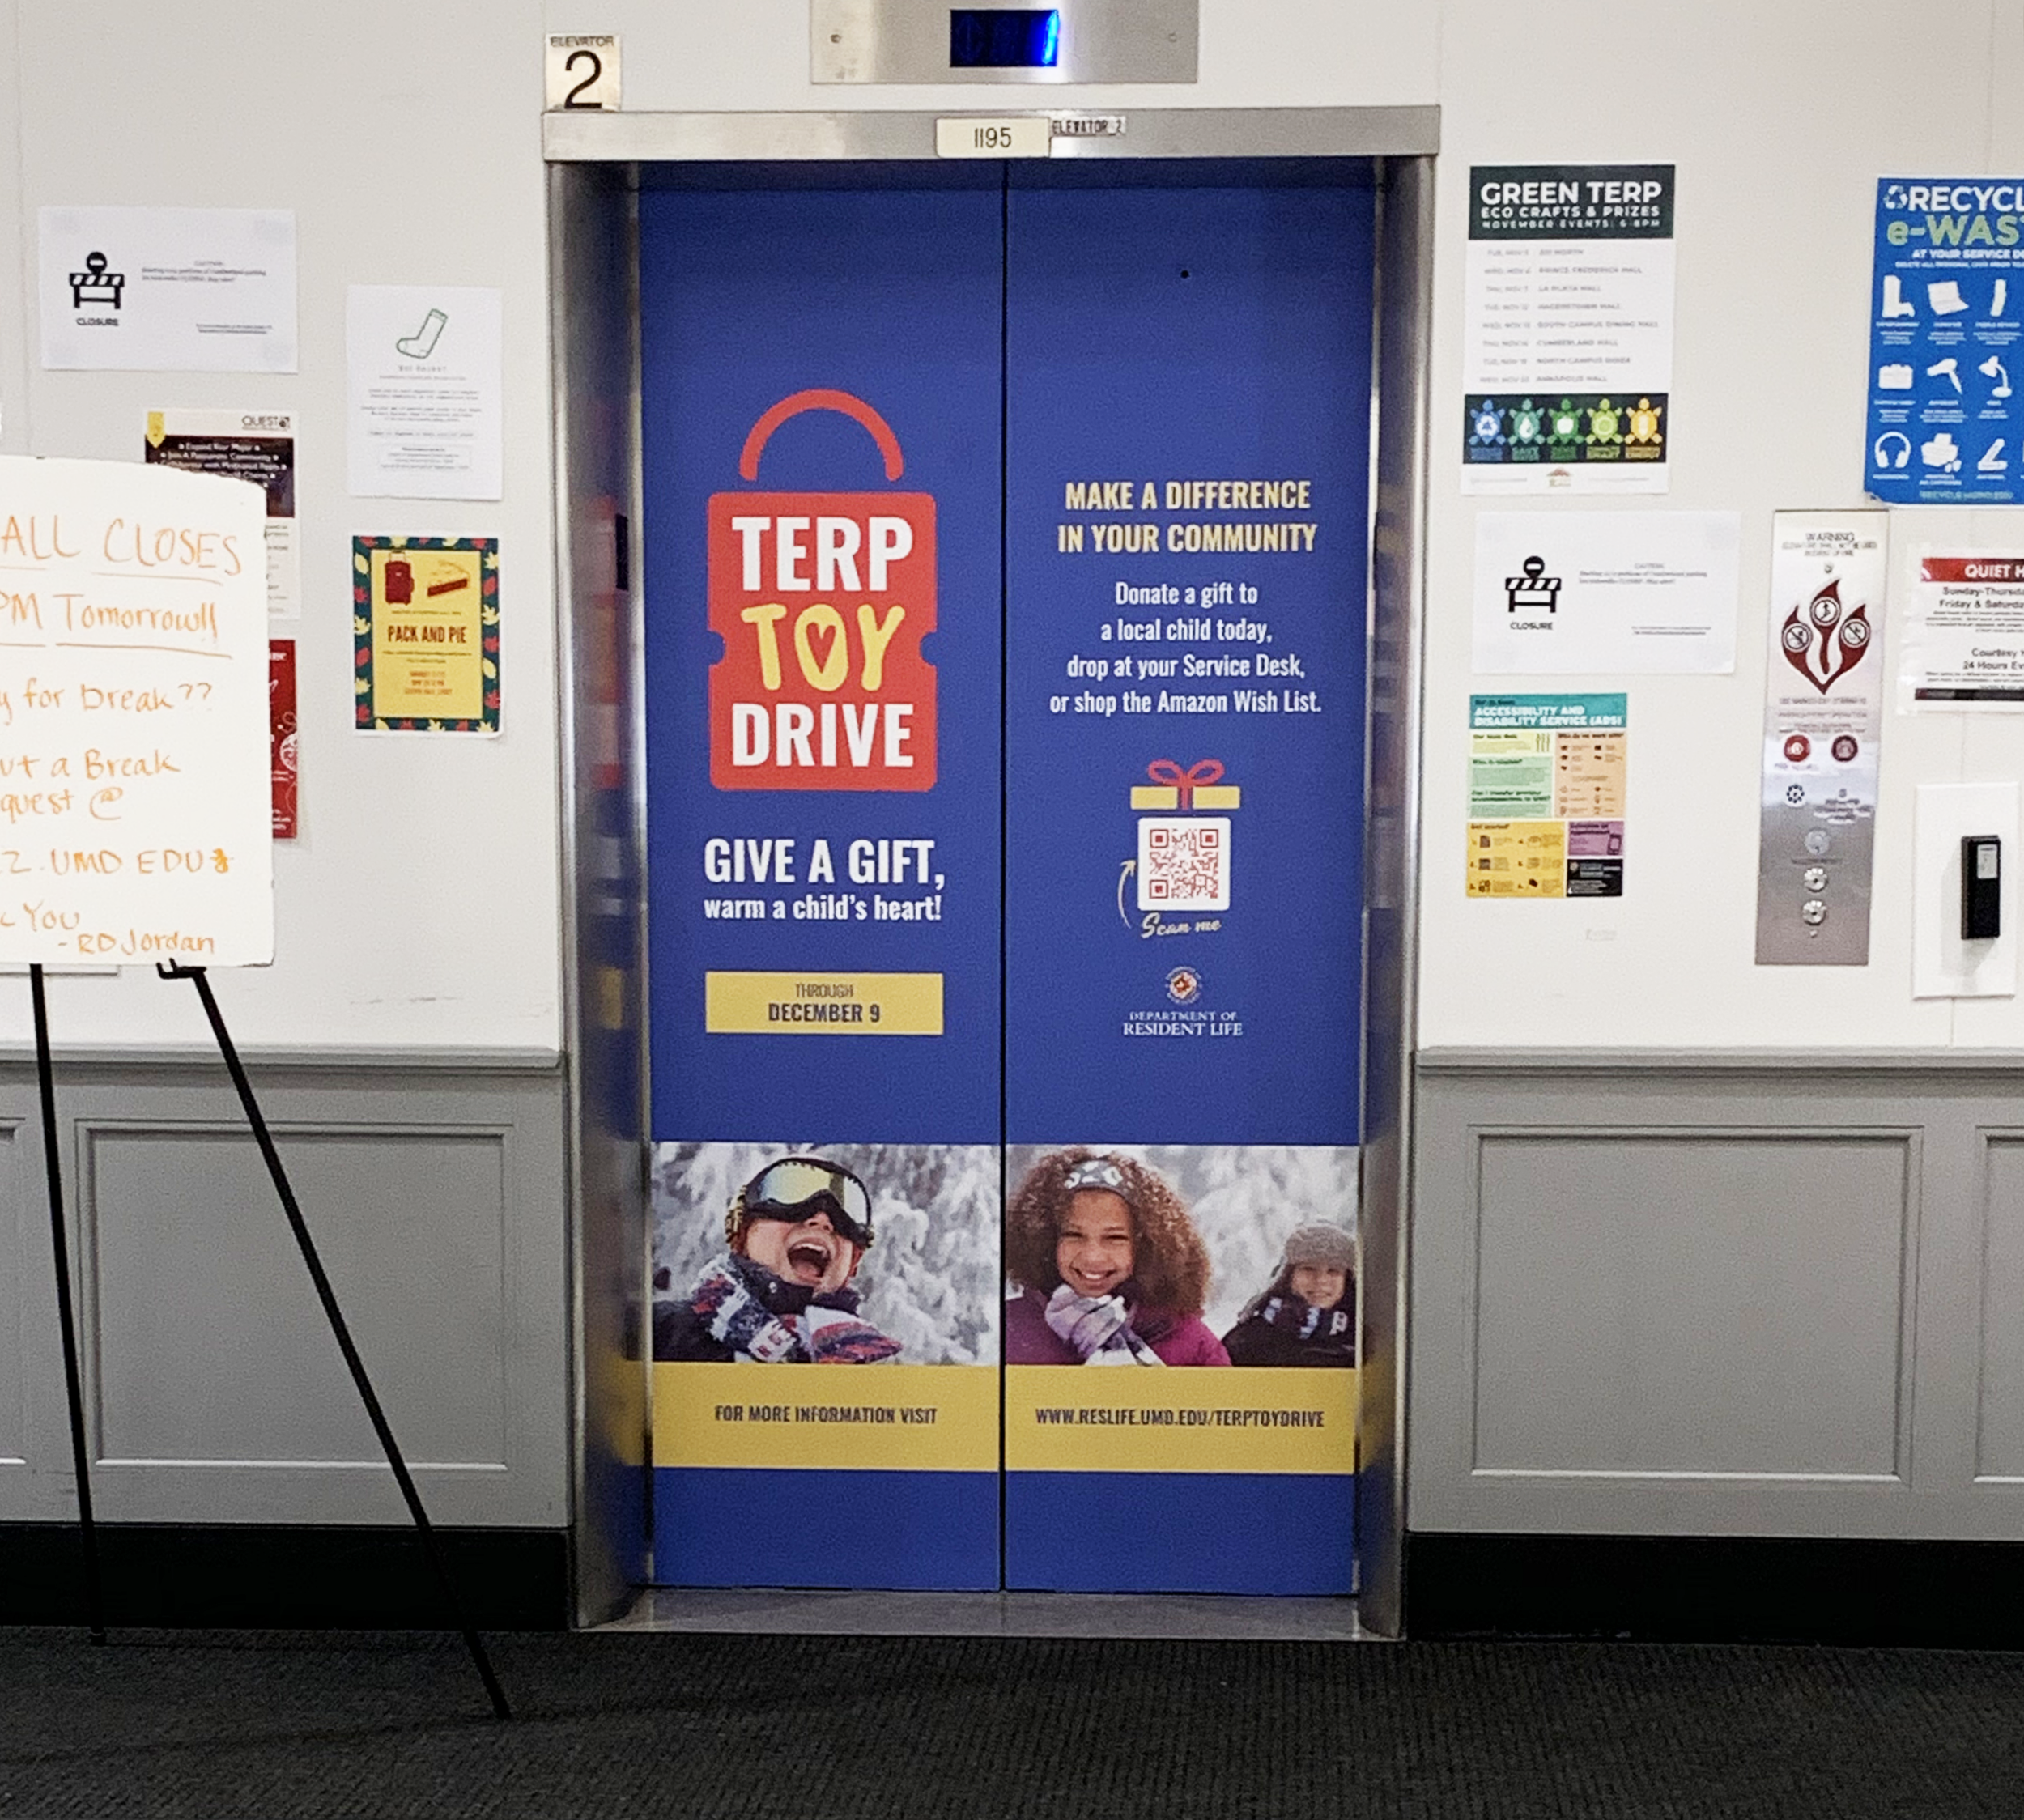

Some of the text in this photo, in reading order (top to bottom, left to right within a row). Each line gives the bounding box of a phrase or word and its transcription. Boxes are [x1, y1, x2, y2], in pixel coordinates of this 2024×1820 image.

[551, 36, 614, 47] ELEVATOR
[564, 50, 602, 109] 2
[975, 127, 1011, 148] 1195
[1052, 119, 1107, 134] ELEVATOR
[1480, 181, 1662, 205] GREEN TERP
[1908, 185, 2024, 212] RECYCL
[1481, 205, 1660, 219] ECO CRAFTS & PRIZES
[1482, 219, 1554, 229] NOVEMBER
[1929, 249, 1961, 259] YOUR
[1962, 249, 2011, 260] SERVICE
[241, 415, 279, 427] QUEST
[1065, 481, 1311, 511] MAKE A DIFFERENCE
[1, 515, 82, 560] ALL
[104, 518, 241, 576] CLOSES
[1058, 524, 1317, 552] IN YOUR COMMUNITY
[731, 517, 913, 592] TERP
[1964, 563, 2011, 579] QUIET
[1115, 582, 1258, 609] Donate a gift to
[1939, 599, 1971, 609] Friday
[1974, 599, 1981, 608] &
[387, 625, 468, 644] PACK AND PIE
[1101, 618, 1273, 644] a local child today,
[1510, 621, 1554, 631] CLOSURE
[741, 603, 906, 691] TOY
[1067, 653, 1305, 681] drop at your Service Desk,
[1977, 661, 2008, 670] Hours
[23, 677, 65, 708] for
[1049, 690, 1322, 717] or shop the Amazon Wish List.
[1473, 705, 1586, 717] ACCESSIBILITY AND
[1473, 716, 1537, 726] DISABILITY
[1539, 716, 1588, 726] SERVICE
[732, 703, 914, 767] DRIVE
[51, 757, 70, 777] a
[85, 748, 181, 780] Break
[0, 786, 123, 823] quest @
[704, 838, 945, 891] GIVE A GIFT,
[704, 894, 942, 921] warm a child's heart!
[1141, 912, 1222, 939] Scan me
[121, 929, 215, 955] Jordan
[795, 983, 854, 998] THROUGH
[768, 1003, 881, 1023] DECEMBER 9
[1129, 1011, 1238, 1022] DEPARTMENT OF
[1123, 1022, 1244, 1036] RESIDENT LIFE
[714, 1405, 938, 1425] FOR MORE INFORMATION VISIT
[1035, 1407, 1325, 1427] WWW.RESLIFE.UMD.EDU/TERPTOYDRIVE
